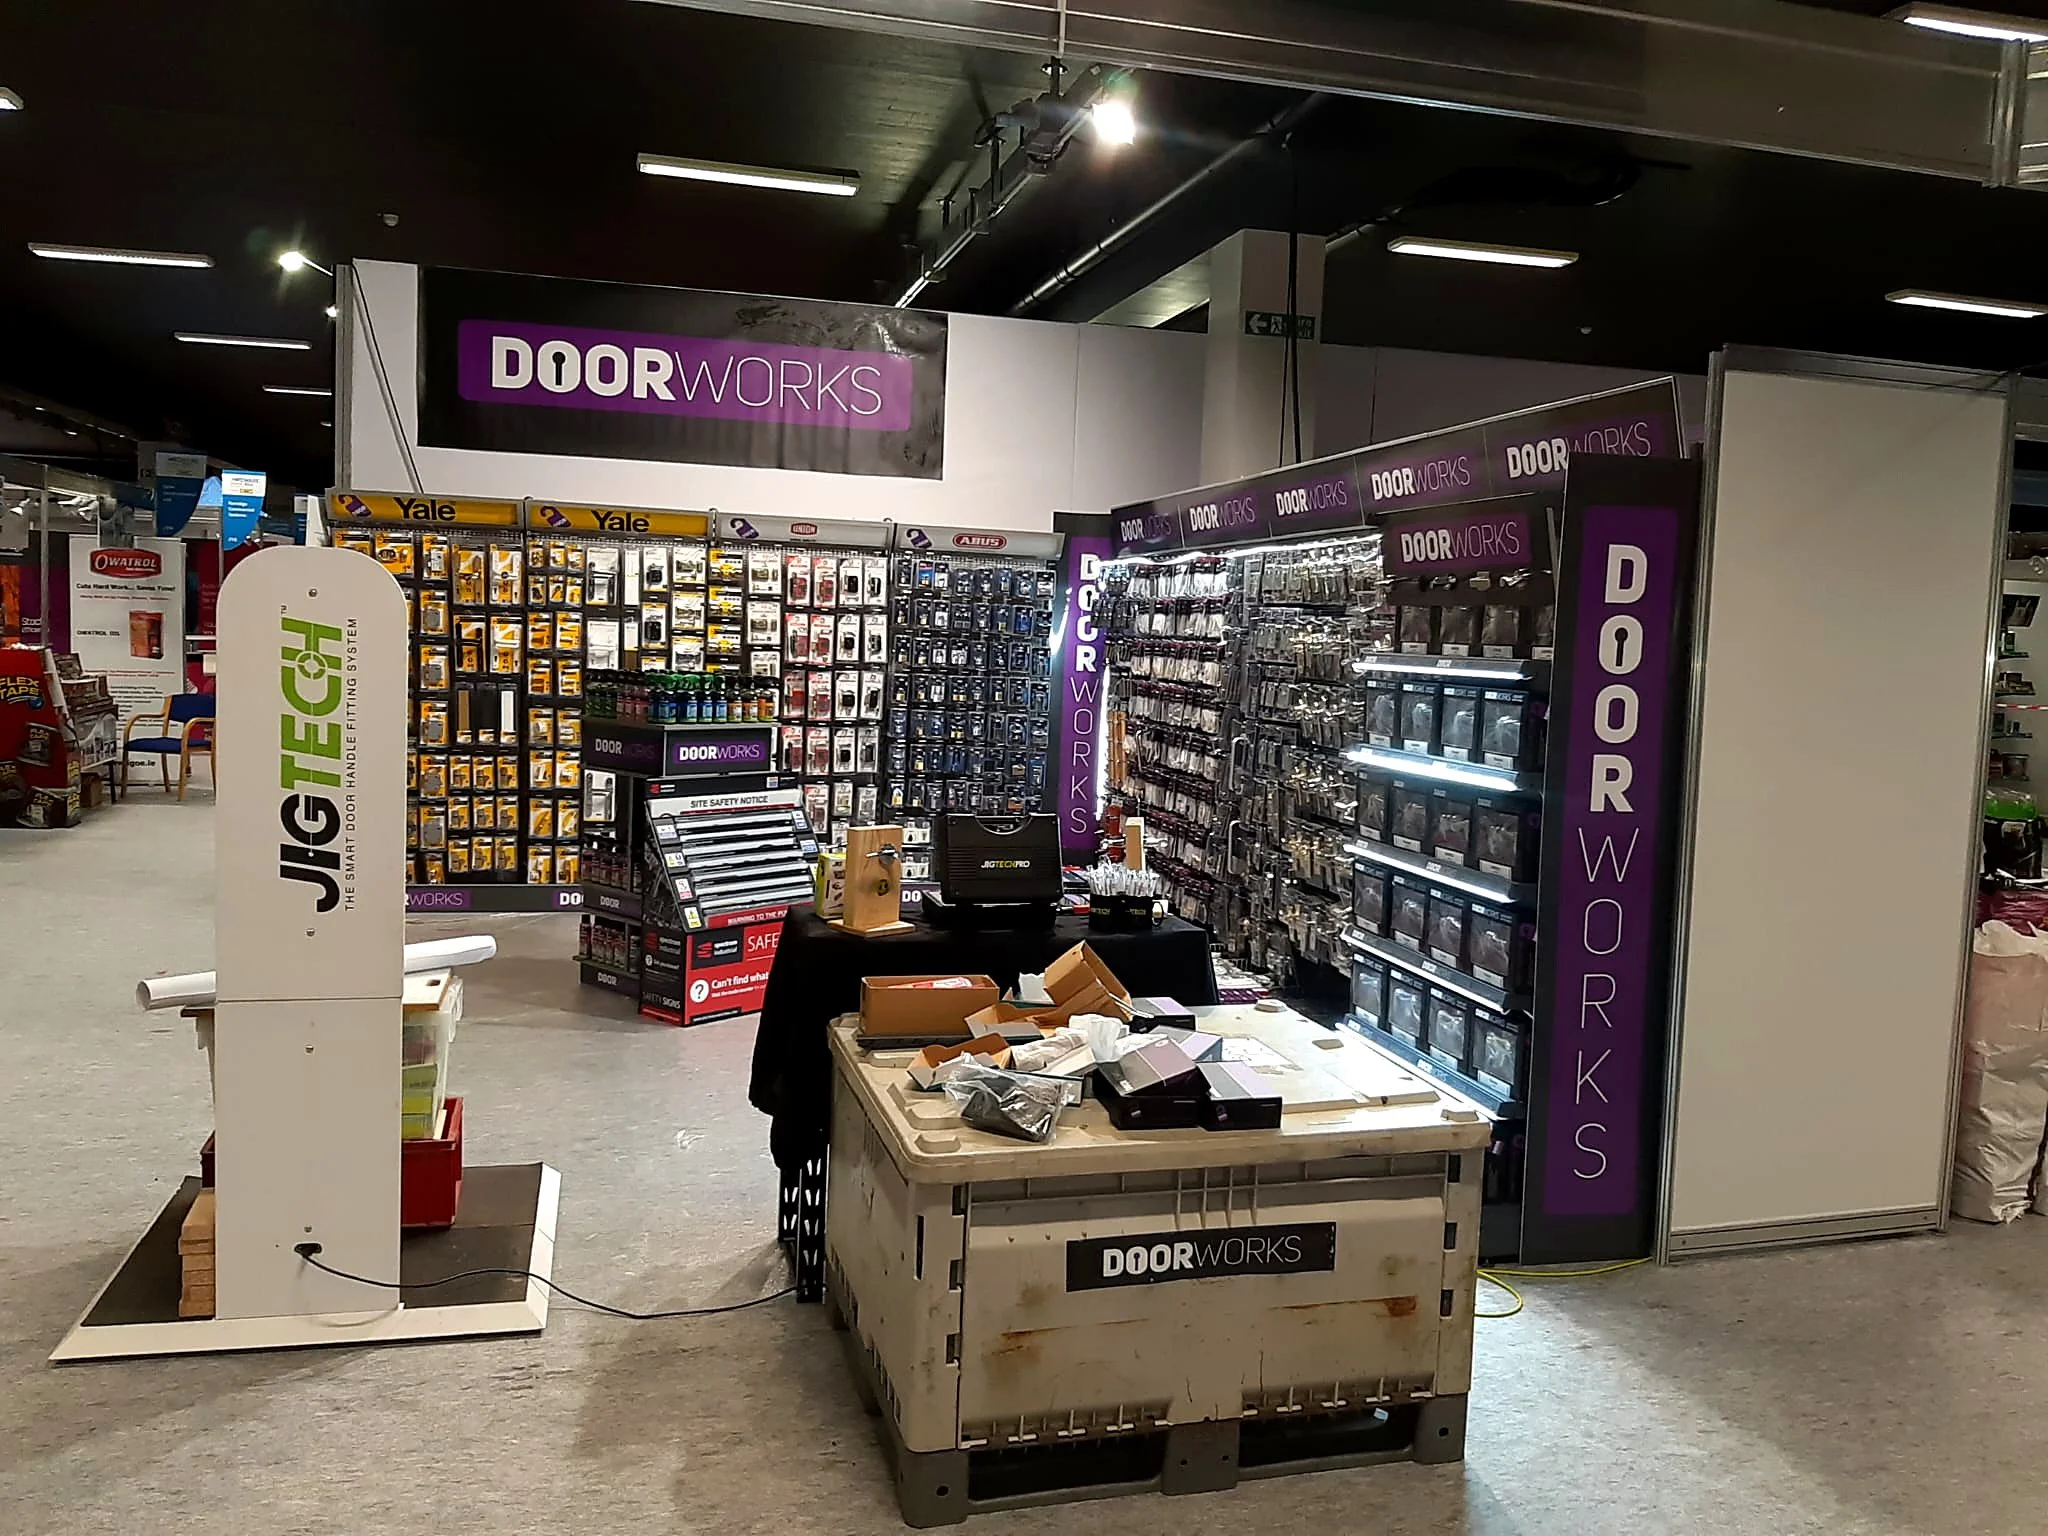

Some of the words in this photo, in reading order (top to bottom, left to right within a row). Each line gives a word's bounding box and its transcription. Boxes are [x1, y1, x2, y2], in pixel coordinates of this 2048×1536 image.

[491, 335, 883, 415] DOORWORKS
[1371, 456, 1471, 501] DOORWORKS
[393, 497, 457, 521] Yale
[1189, 497, 1257, 532] DOORWORKS
[1275, 480, 1348, 516] DOORWORKS
[591, 510, 650, 532] Yale
[959, 536, 1000, 546] ABUS
[1400, 522, 1521, 564] DOORWORKS
[94, 554, 158, 570] OWATROL
[347, 618, 357, 672] SYSTEM
[0, 686, 39, 700] TAPE
[346, 678, 357, 730] FITTING
[280, 616, 342, 913] JIGTECH
[345, 736, 357, 788] HANDLE
[679, 744, 760, 761] DOORWORKS
[345, 794, 356, 831] DOOR
[690, 800, 708, 809] SITE
[709, 797, 740, 807] SAFETY
[740, 795, 769, 805] NOTICE
[345, 837, 356, 880] SMART
[1573, 543, 1648, 1180] DOORWORKS
[345, 887, 356, 912] THE
[747, 931, 781, 953] SAFE
[711, 976, 733, 989] Can't
[733, 973, 750, 986] find
[1102, 1235, 1302, 1278] DOORWORKS
